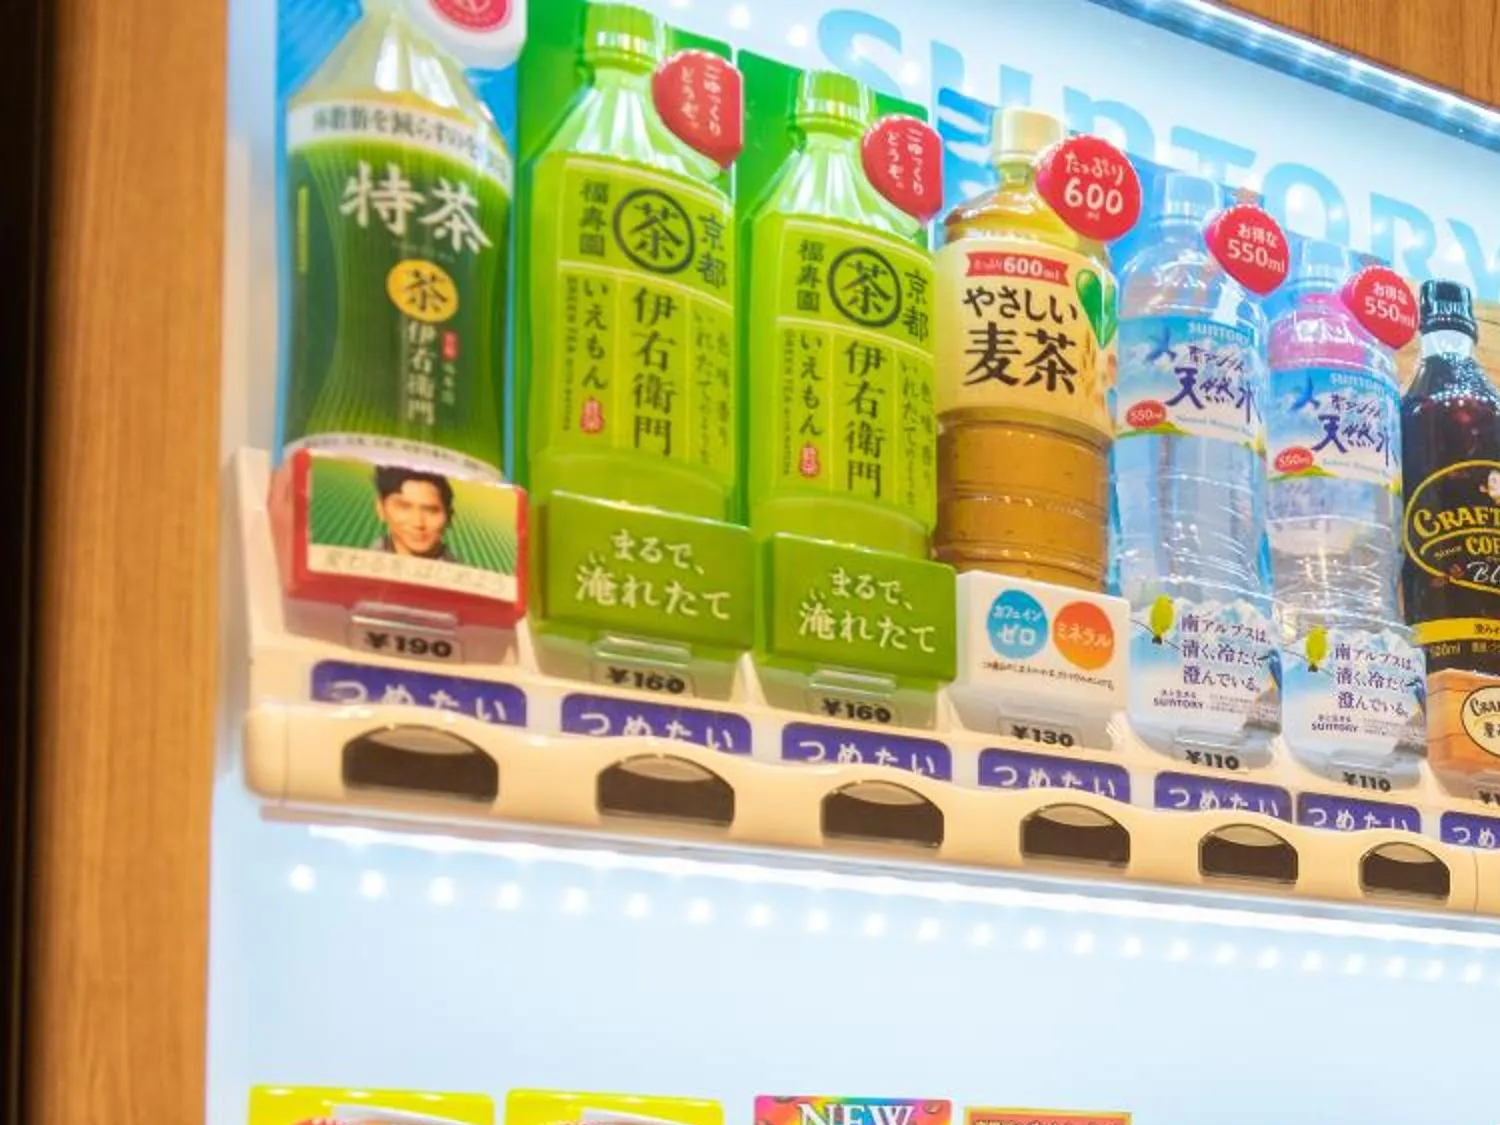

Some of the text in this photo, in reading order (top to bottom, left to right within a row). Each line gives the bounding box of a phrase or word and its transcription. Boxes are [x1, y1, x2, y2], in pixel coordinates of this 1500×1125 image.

[1064, 151, 1126, 186] たっぷり
[339, 160, 495, 256] 特茶
[1063, 177, 1125, 216] 600
[628, 198, 682, 262] 茶
[1236, 222, 1280, 250] お得な
[695, 213, 729, 290] 京都
[1226, 239, 1287, 274] 550ml
[403, 271, 448, 314] 茶
[839, 257, 894, 318] 茶
[902, 268, 931, 343] 京都
[962, 285, 1079, 326] やさしい
[1371, 280, 1410, 306] お得な
[1363, 298, 1416, 330] 550ml
[581, 279, 609, 390] いえもん
[406, 322, 437, 426] 伊右衛門
[630, 286, 680, 457] 伊右衛門
[963, 320, 1079, 394] 麦茶
[798, 334, 824, 437] いえもん
[842, 340, 888, 498] 伊右衛門
[611, 528, 706, 577] まるで、
[575, 563, 733, 621] 淹れたて
[829, 566, 914, 612] まるで、
[364, 630, 453, 658] ¥190
[797, 599, 937, 654] 淹れたて
[1056, 622, 1113, 650] ミネラル
[1181, 612, 1272, 646] 南アルプスは、
[605, 666, 686, 694] ¥160
[1183, 665, 1262, 693] 澄んでいる。
[331, 681, 507, 722] つめたい
[821, 698, 893, 724] ¥160
[580, 710, 735, 750] つめたい
[1011, 723, 1076, 749] ¥130
[799, 739, 937, 777] つめたい
[1184, 749, 1240, 771] ¥110
[993, 764, 1118, 798] つめたい
[1341, 771, 1392, 793] ¥110
[1167, 786, 1280, 819] つめたい
[1307, 806, 1410, 831] つめたい
